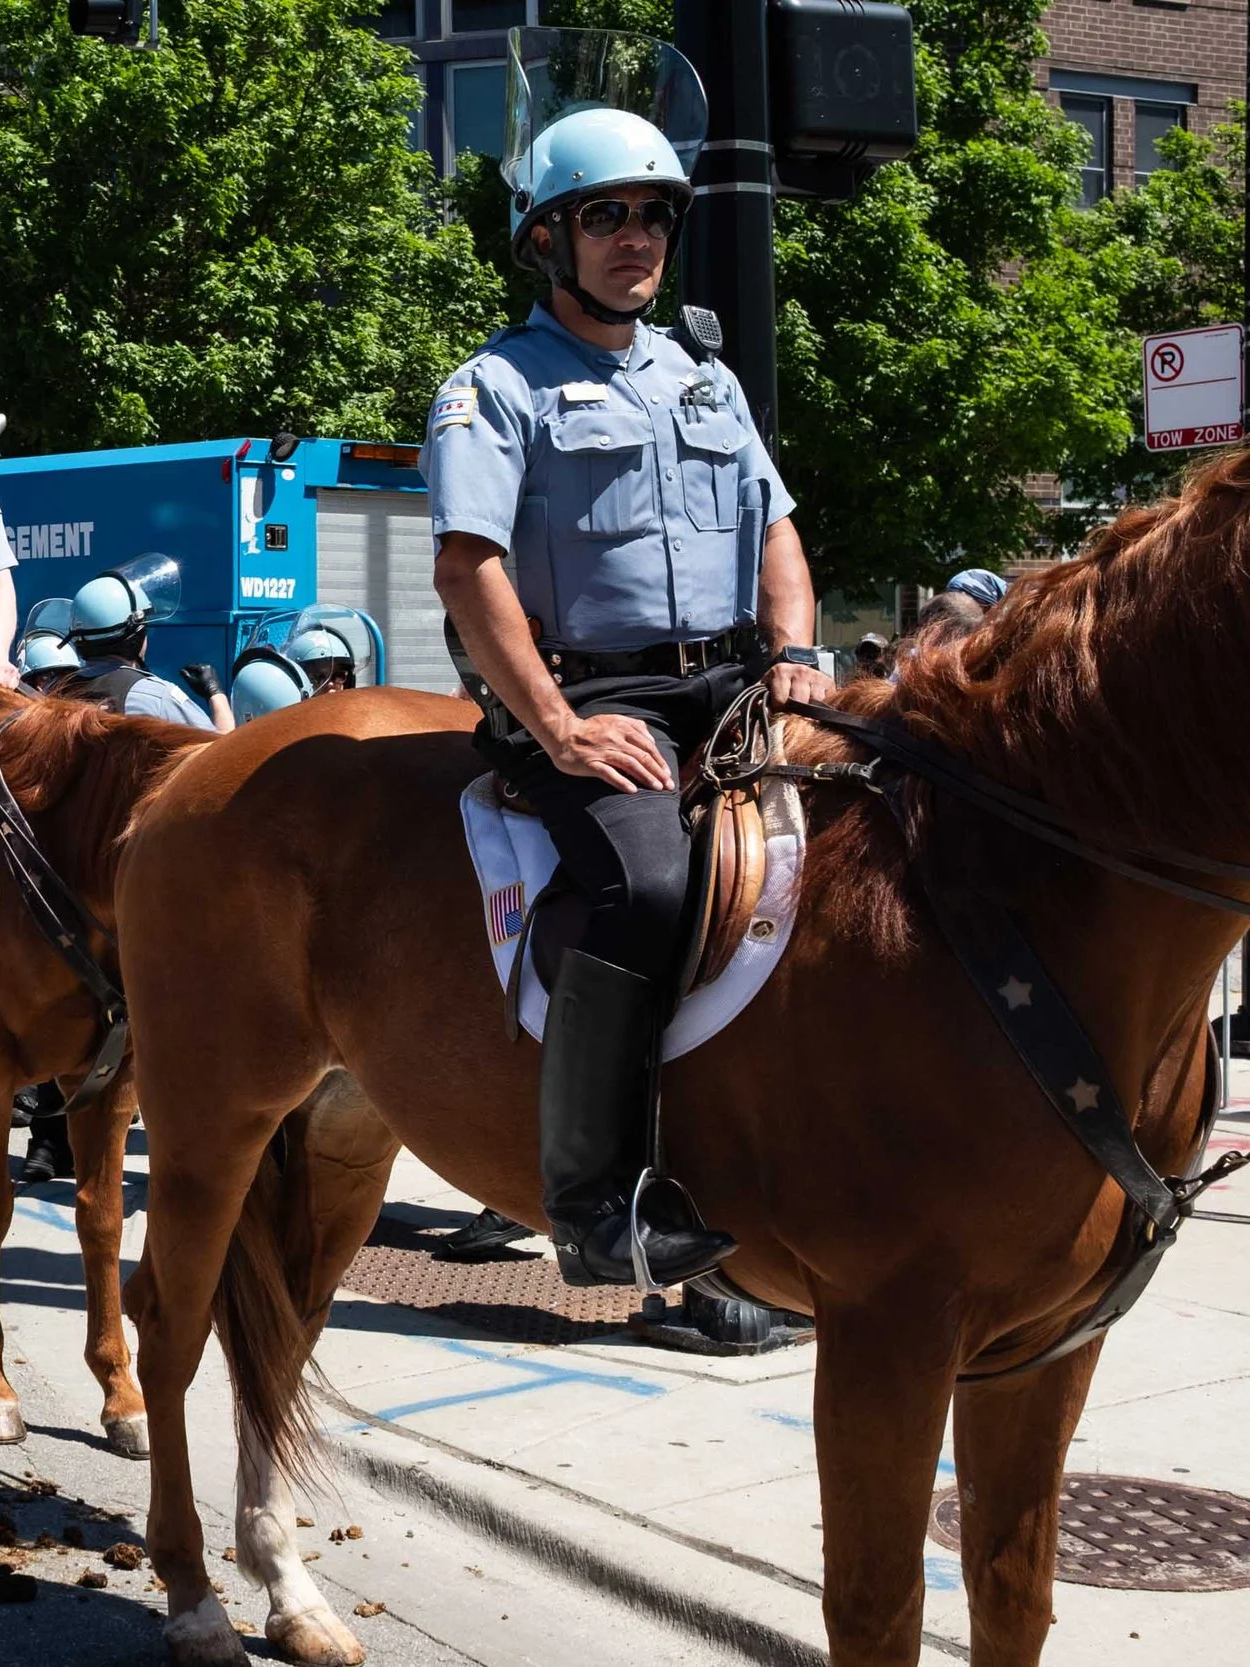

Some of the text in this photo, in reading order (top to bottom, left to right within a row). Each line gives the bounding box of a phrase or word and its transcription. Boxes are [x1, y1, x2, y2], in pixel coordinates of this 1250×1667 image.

[1151, 424, 1238, 448] TOW ZONE
[240, 577, 296, 599] WD1227
